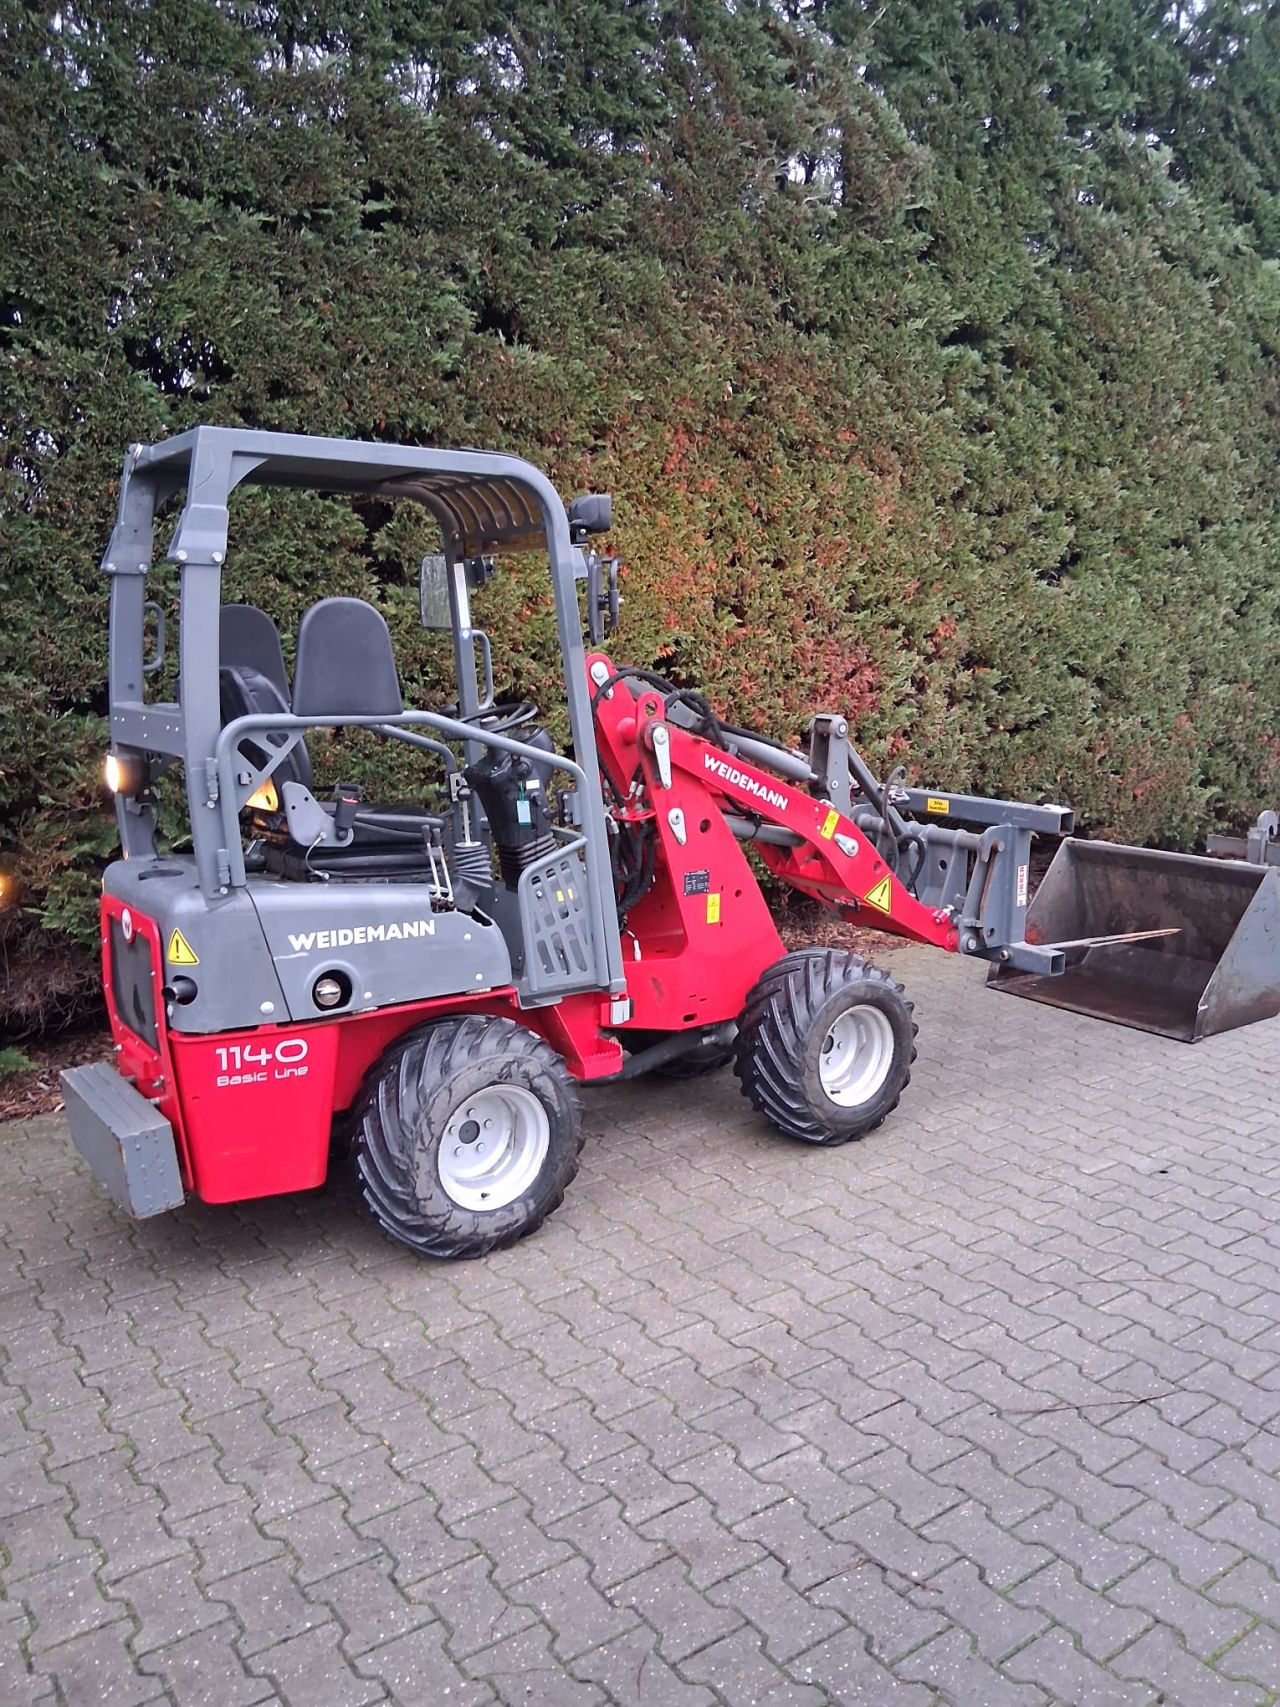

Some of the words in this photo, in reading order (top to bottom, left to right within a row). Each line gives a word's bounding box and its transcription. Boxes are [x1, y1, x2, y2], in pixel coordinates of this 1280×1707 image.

[704, 753, 788, 811] WEIDEMANN
[288, 919, 435, 951] WEIDEMANN
[215, 1039, 308, 1071] 1140
[216, 1072, 268, 1087] Basic
[275, 1066, 309, 1079] Line
